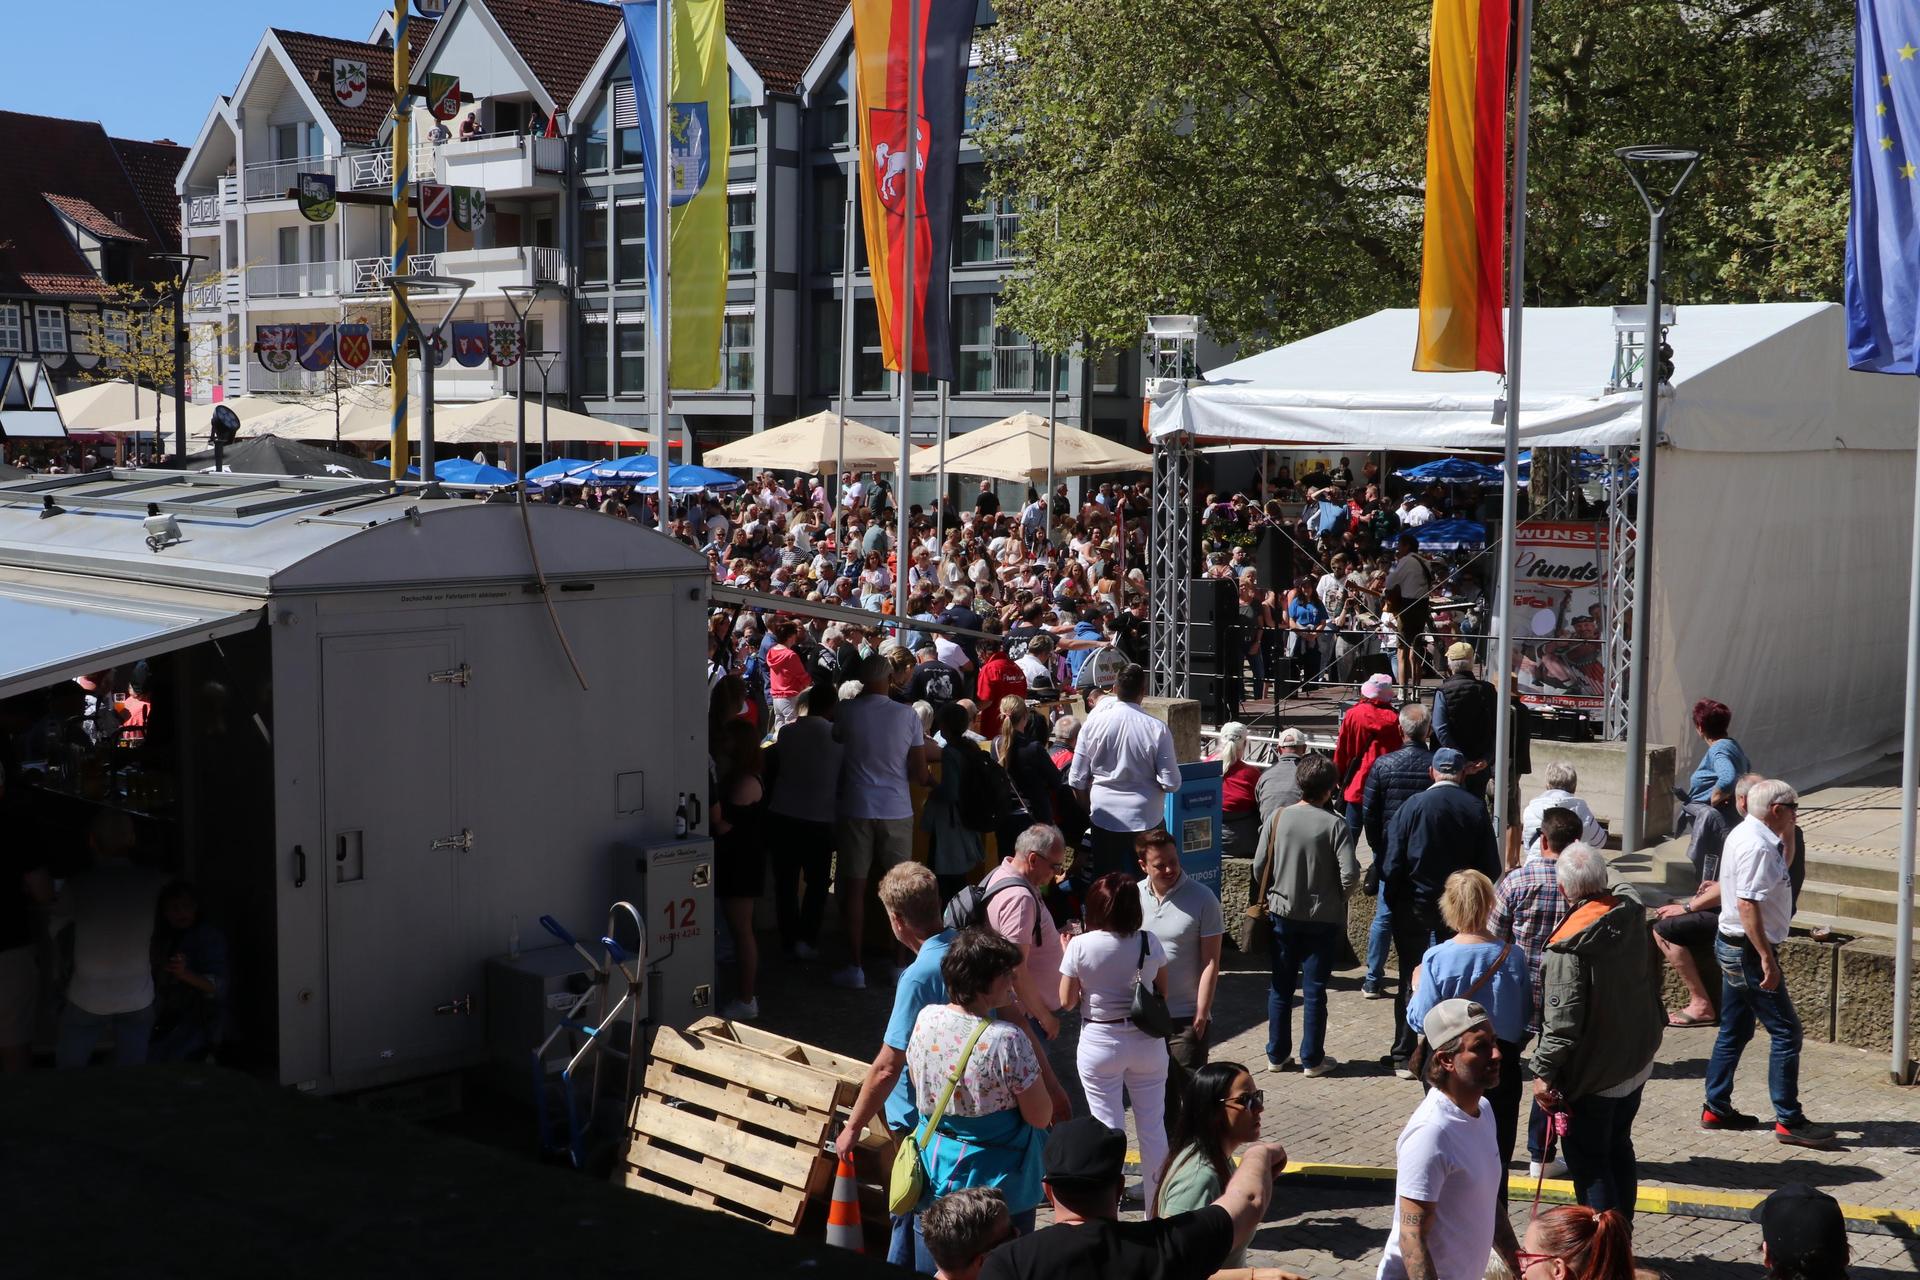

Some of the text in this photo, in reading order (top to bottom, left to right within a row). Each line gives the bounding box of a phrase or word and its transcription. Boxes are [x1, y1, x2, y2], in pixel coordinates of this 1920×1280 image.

[1515, 529, 1609, 541] WUNST
[1539, 695, 1575, 706] Jahren
[1577, 697, 1604, 709] präse
[664, 898, 696, 929] 12
